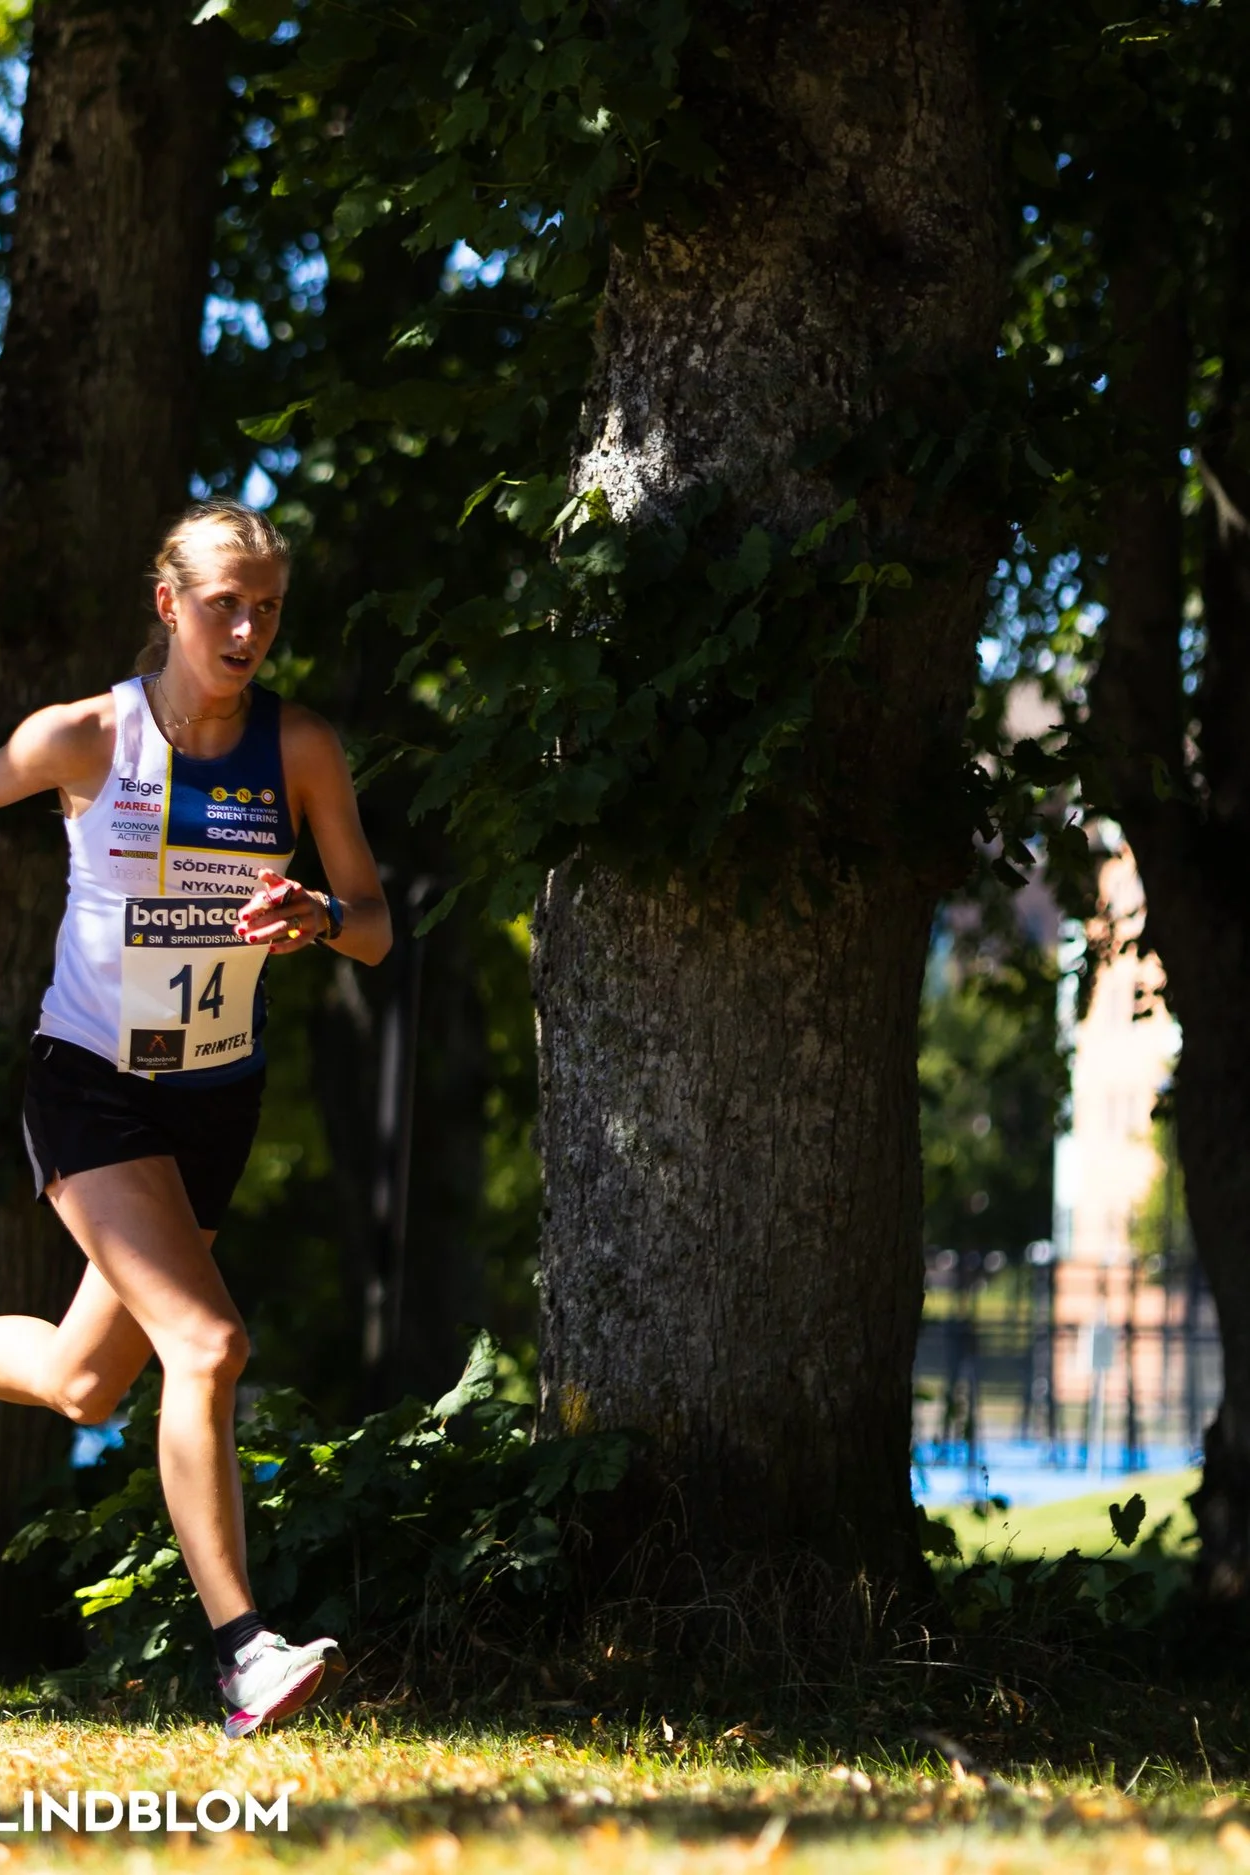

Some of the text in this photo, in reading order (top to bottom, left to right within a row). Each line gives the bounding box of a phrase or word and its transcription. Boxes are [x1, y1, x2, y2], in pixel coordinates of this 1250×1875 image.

[119, 778, 163, 796] Telge
[114, 801, 161, 812] MARELD
[207, 811, 278, 823] ORIENTERING
[111, 821, 160, 832] AVONOVA
[117, 832, 151, 842] ACTIVE
[206, 827, 277, 845] SCANIA
[181, 880, 254, 896] NYKVARN
[149, 935, 243, 944] SM SPRINTDISTANS
[169, 961, 225, 1025] 14
[194, 1032, 248, 1057] TRIMTEX
